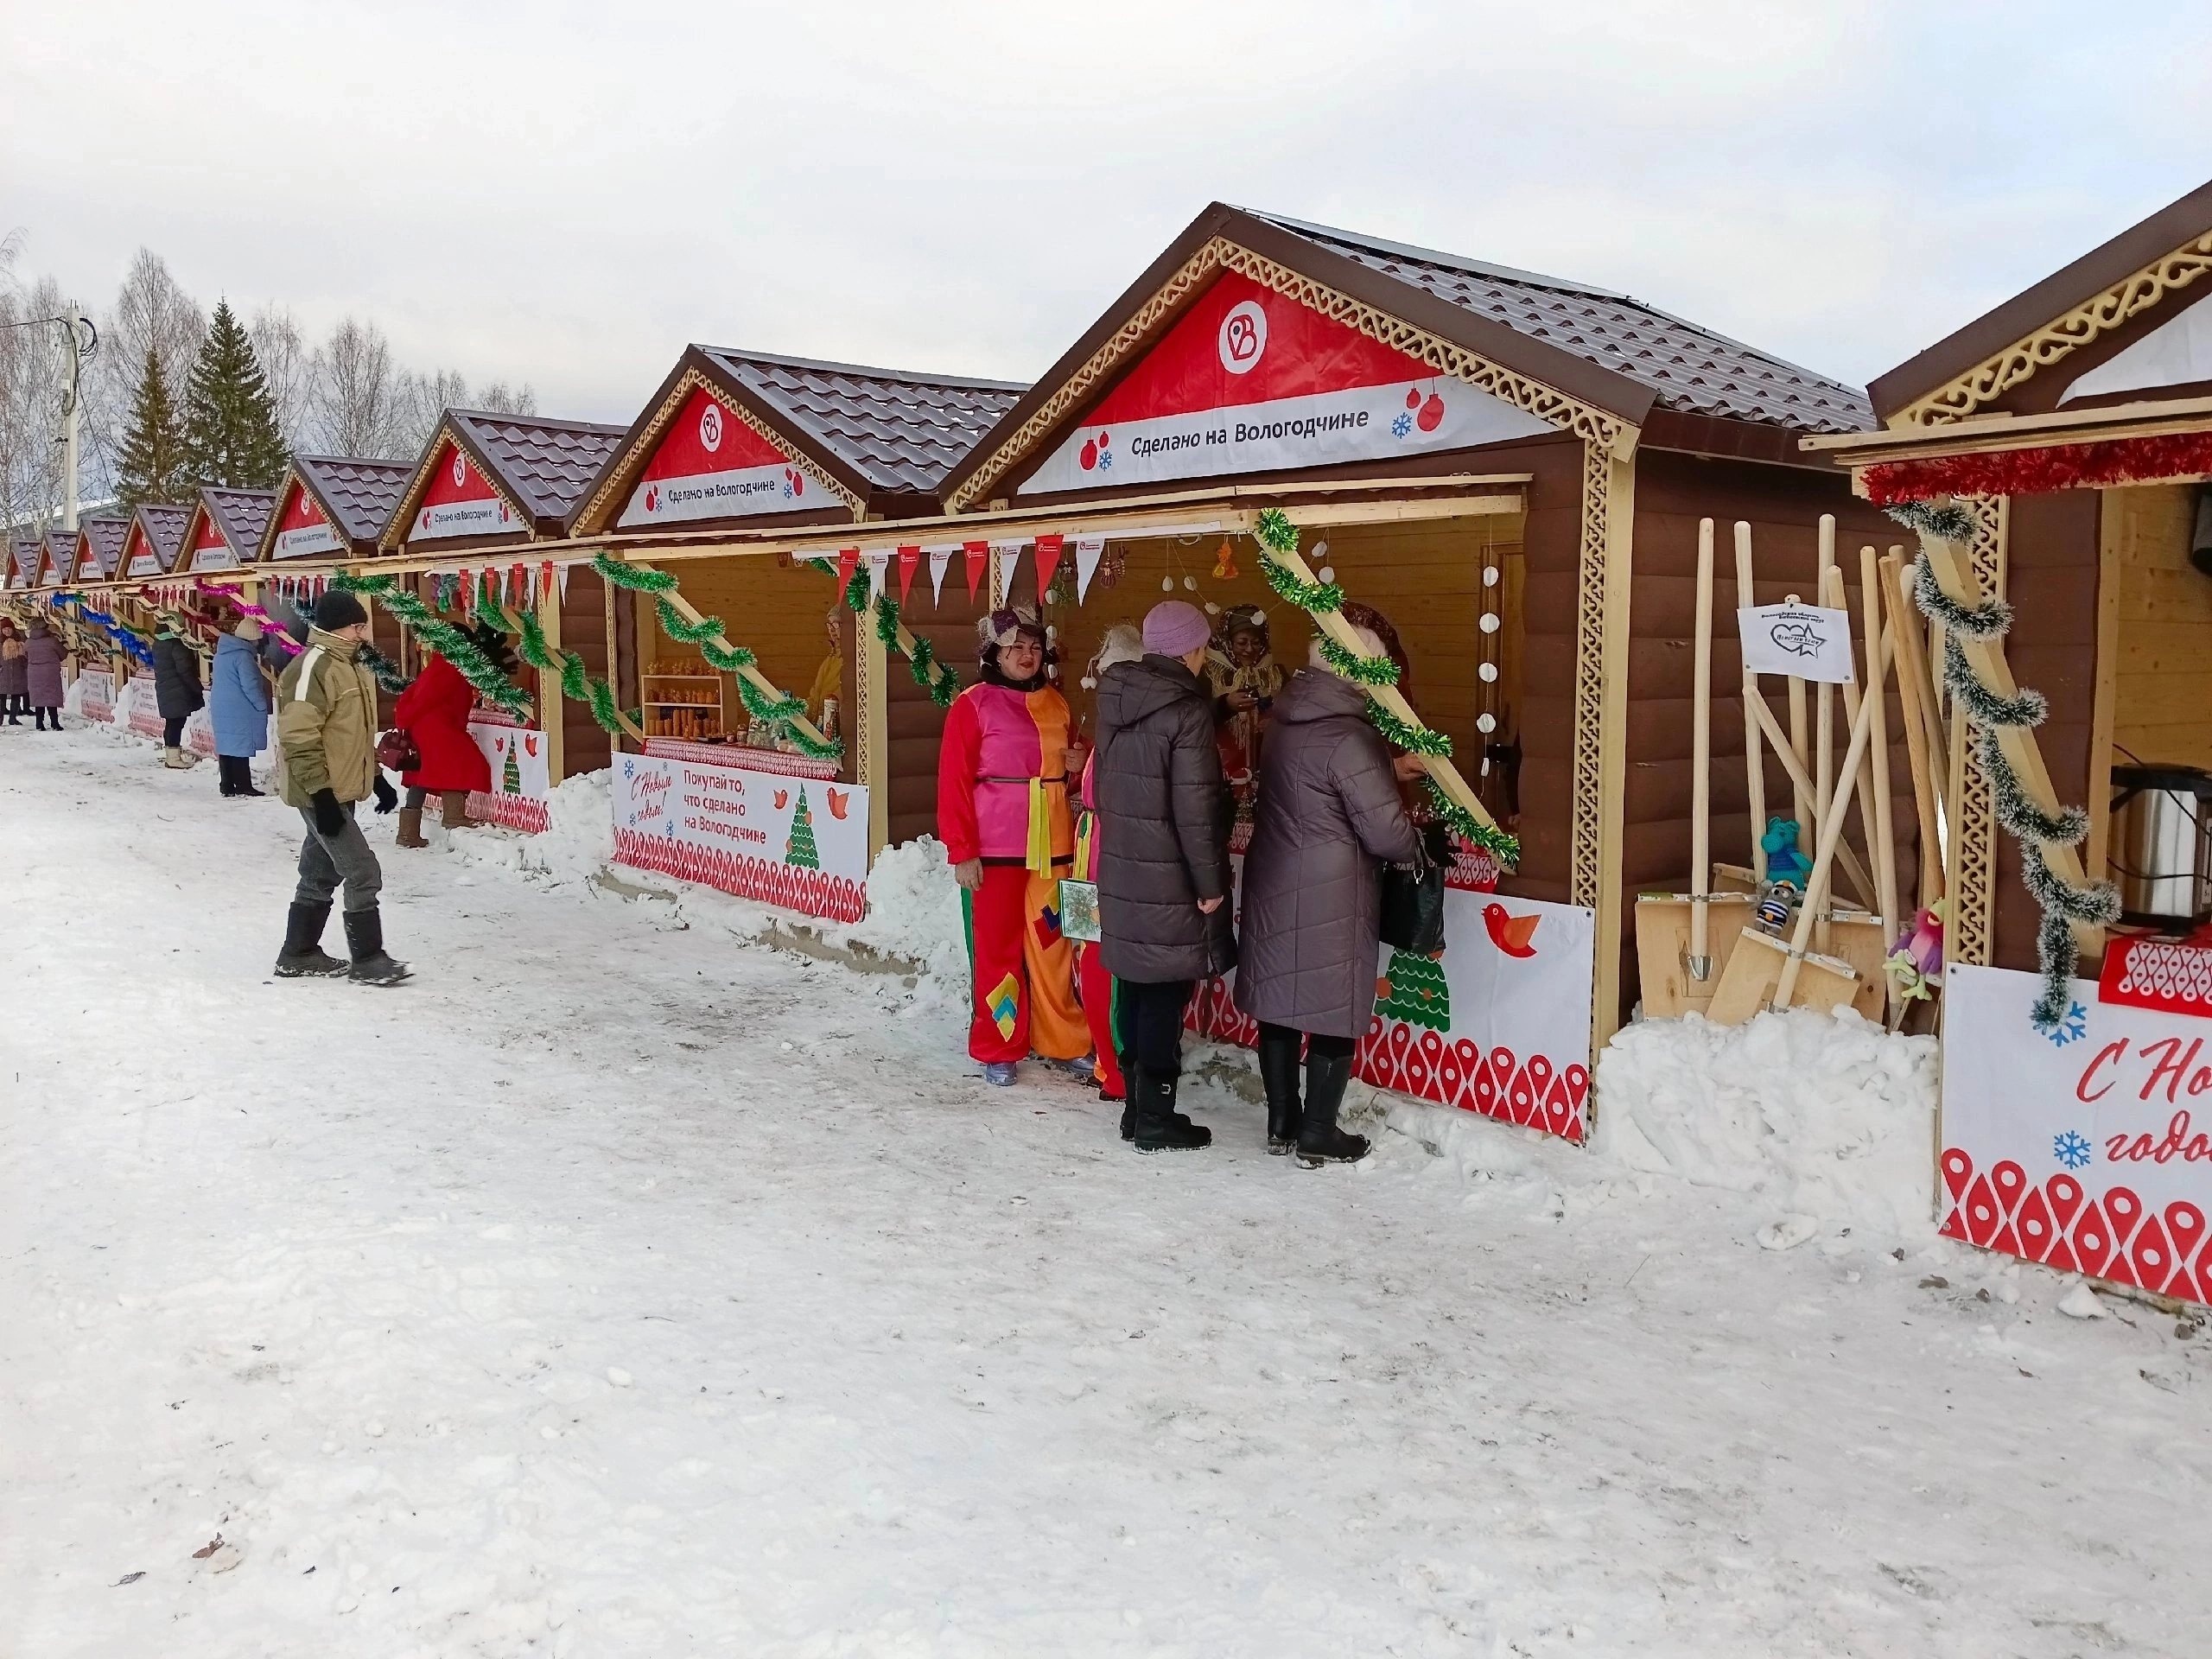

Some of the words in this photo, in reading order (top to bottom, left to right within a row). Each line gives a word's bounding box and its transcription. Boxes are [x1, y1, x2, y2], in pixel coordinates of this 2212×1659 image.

[1131, 431, 1200, 457] Сделано
[1206, 428, 1227, 446] на
[1235, 410, 1370, 442] Вологодчине
[668, 487, 702, 504] Сделано
[704, 486, 715, 499] на
[716, 479, 775, 497] Вологодчине
[631, 773, 641, 801] С
[641, 771, 672, 798] Новым
[683, 769, 727, 792] Покупай
[728, 779, 746, 796] то,
[683, 794, 701, 808] что
[703, 797, 746, 817] сделано
[684, 817, 696, 830] на
[700, 816, 766, 844] Вологодчине
[2076, 1037, 2130, 1103] С
[2105, 1109, 2212, 1164] годо
